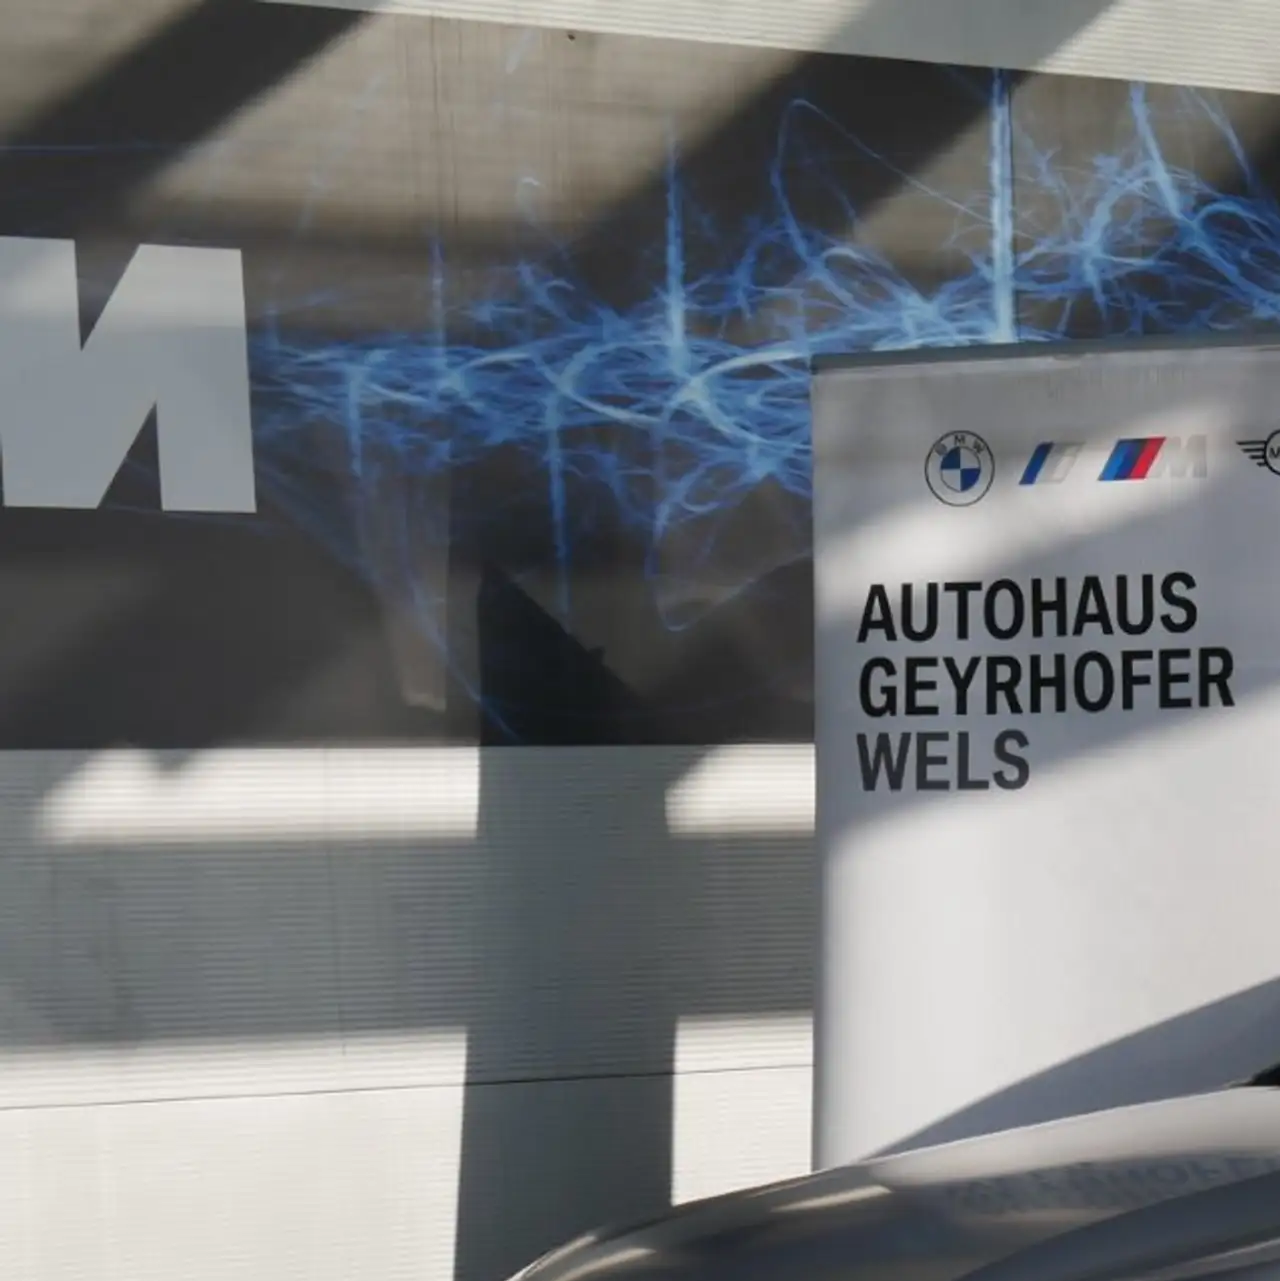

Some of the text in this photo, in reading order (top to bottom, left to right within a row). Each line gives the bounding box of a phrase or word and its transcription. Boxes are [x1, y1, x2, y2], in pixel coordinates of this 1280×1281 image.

[856, 571, 1198, 643] AUTOHAUS
[858, 646, 1236, 718] GEYRHOFER
[855, 729, 1031, 792] WELS
